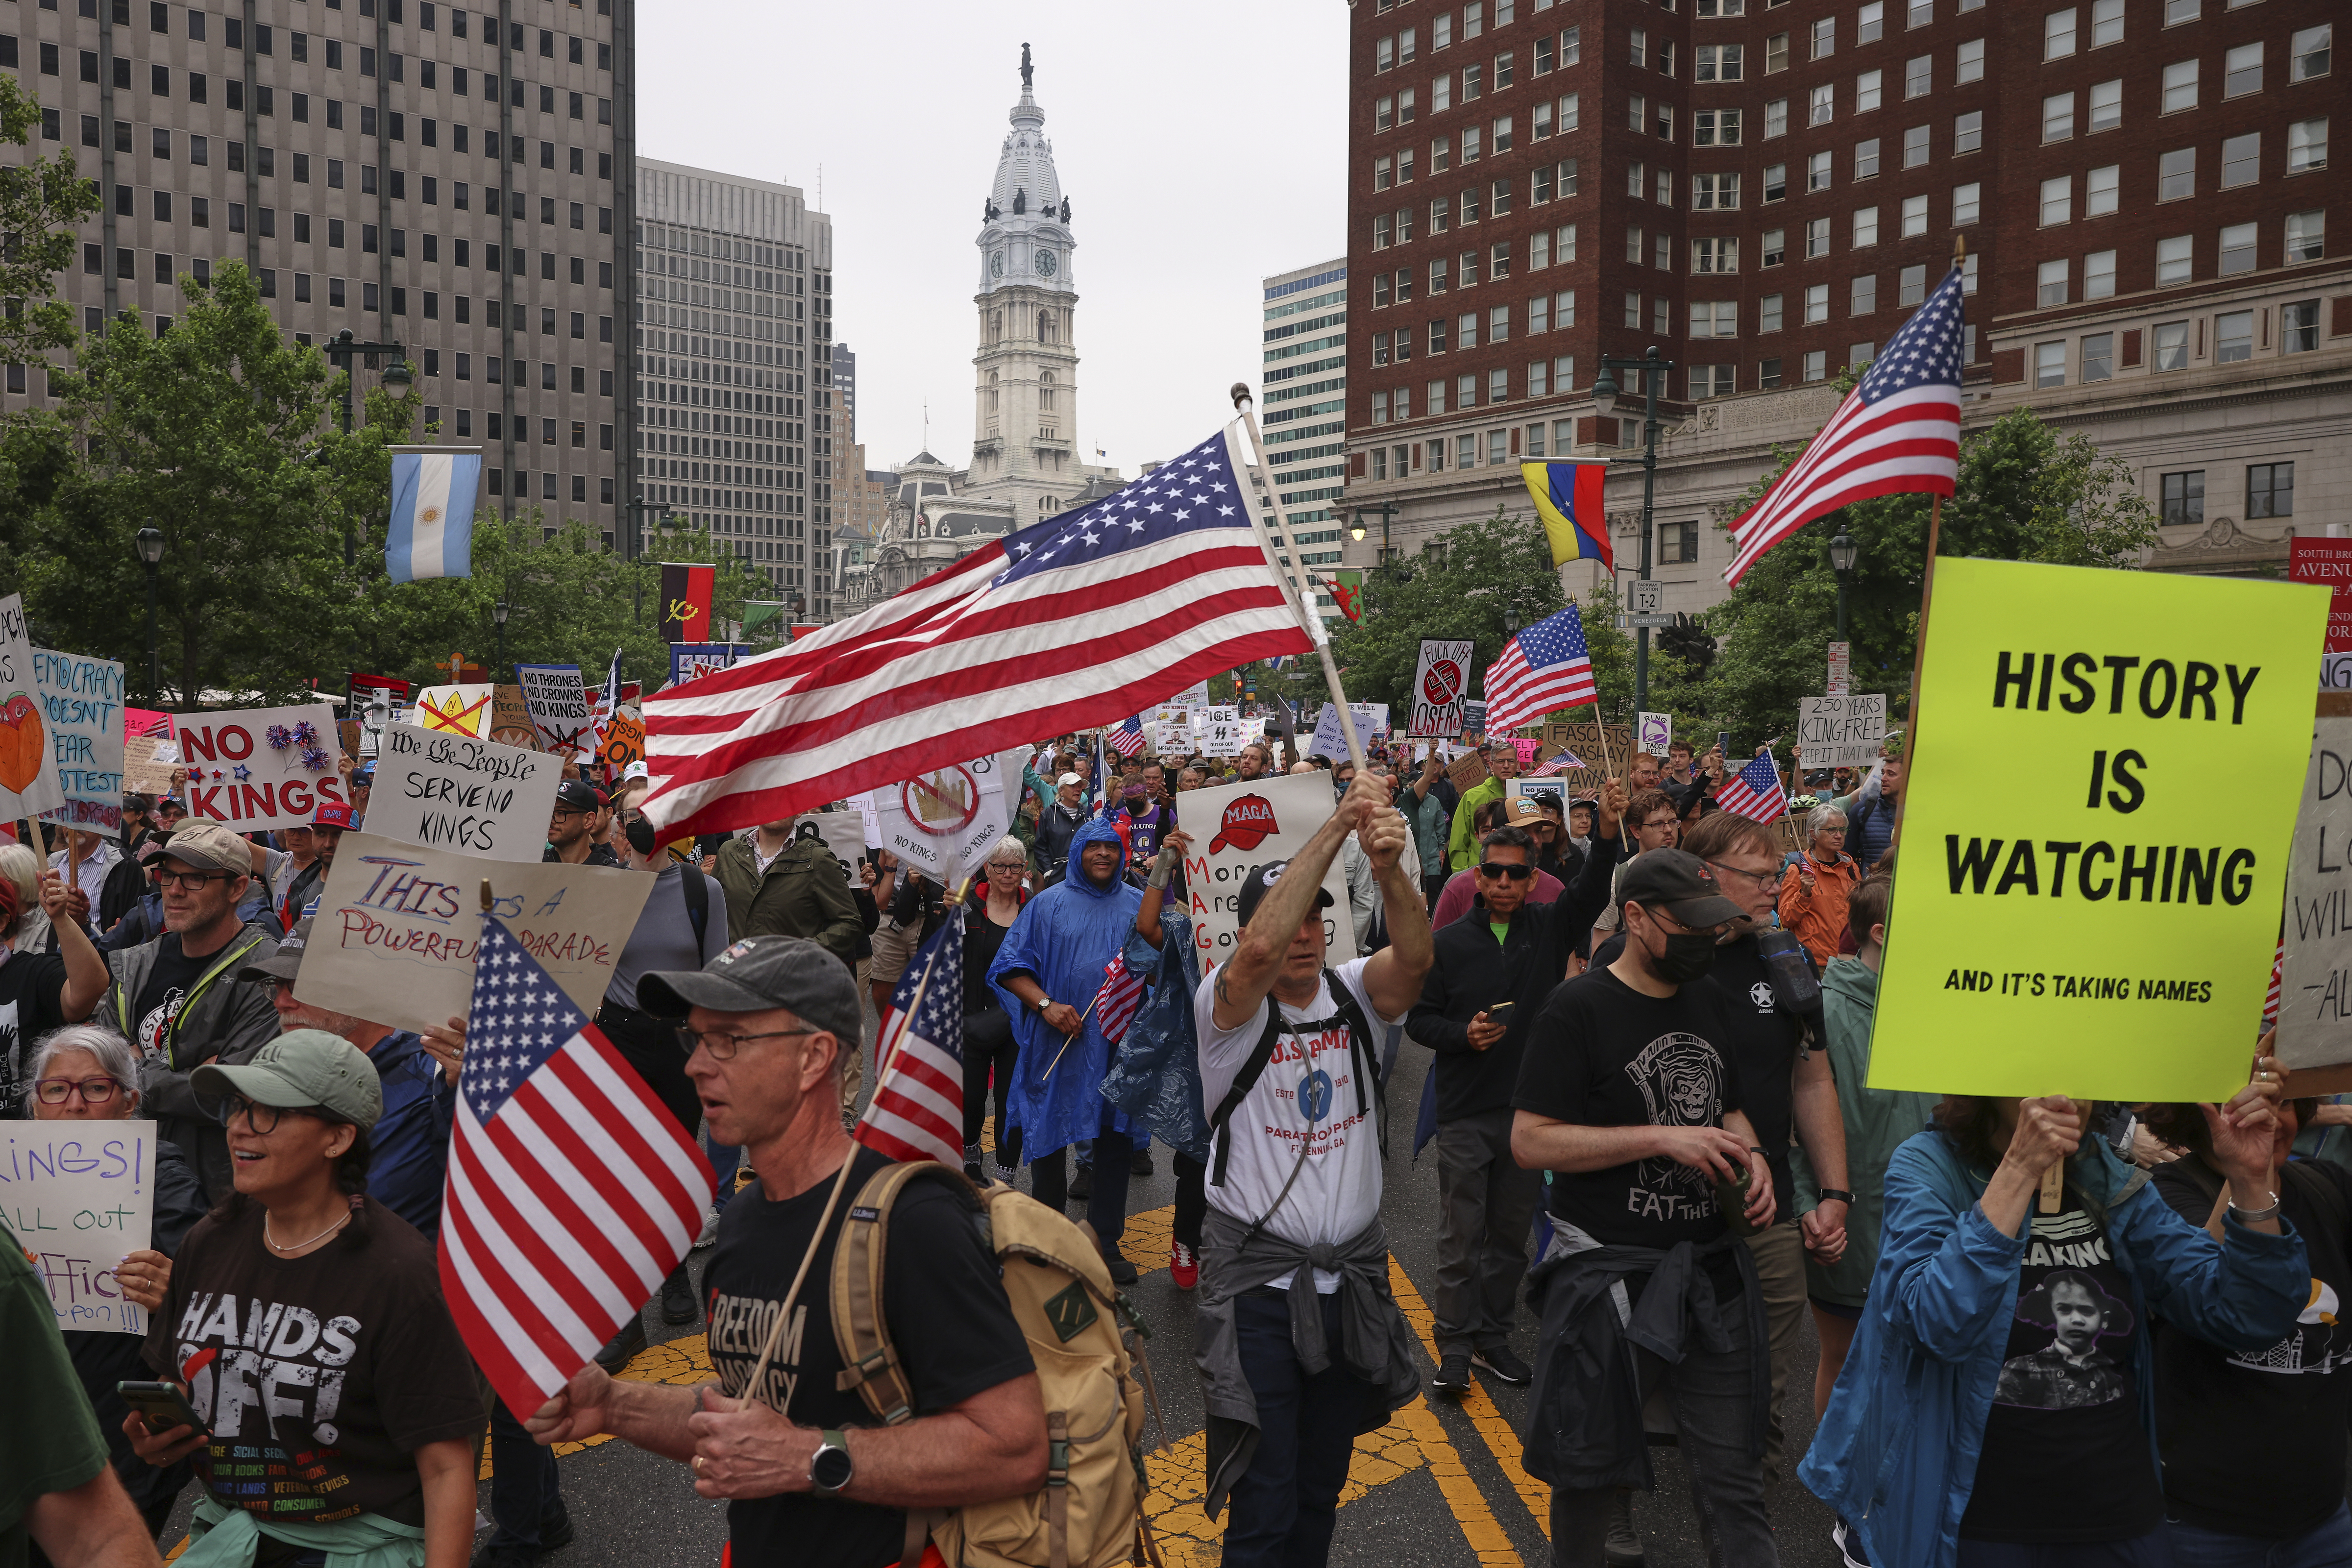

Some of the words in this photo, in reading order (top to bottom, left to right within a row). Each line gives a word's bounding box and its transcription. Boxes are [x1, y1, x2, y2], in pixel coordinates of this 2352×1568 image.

[1723, 401, 1750, 410] INSURANCE
[1752, 396, 1779, 405] COMPANY
[1761, 416, 1791, 424] DECLARATION
[2298, 549, 2332, 558] SOUTH
[1640, 594, 1655, 607] T-2
[1424, 641, 1450, 665] FUCK
[1451, 641, 1472, 665] OFF
[33, 654, 123, 701] EMOCRACY
[524, 672, 538, 685] NO
[538, 674, 582, 687] THRONES
[527, 686, 540, 699] NO
[542, 687, 584, 702] CROWNS
[1993, 651, 2261, 725] HISTORY
[530, 700, 547, 716] NO
[548, 702, 587, 718] KINGS
[1209, 710, 1232, 722] ICE
[1409, 693, 1466, 736] LOSERS
[1812, 699, 1842, 713] 250
[1845, 698, 1881, 716] YEARS
[1241, 720, 1263, 729] FASCIST
[1323, 723, 1337, 734] Pissed
[1644, 715, 1668, 723] RING
[1318, 732, 1336, 741] WAKE
[1553, 725, 1630, 746] FASCISTS
[1801, 717, 1883, 743] KING-FREE
[179, 724, 254, 763] NO
[1569, 744, 1626, 762] SASHAY
[391, 730, 422, 756] We
[425, 739, 456, 763] the
[455, 742, 537, 783] People
[1800, 749, 1820, 763] KEEP
[1819, 748, 1833, 762] IT
[1837, 746, 1862, 762] THAT
[59, 769, 123, 792] OTEST
[1457, 766, 1481, 786] STUPID
[1569, 769, 1623, 789] AWAY
[2086, 749, 2148, 814] IS
[191, 777, 344, 821] KINGS
[404, 772, 486, 808] SERVE
[486, 788, 513, 814] NO
[1226, 804, 1273, 824] MAGA
[418, 810, 497, 851] KINGS
[894, 834, 908, 848] NO
[909, 842, 938, 862] KINGS
[960, 846, 973, 861] NO
[970, 824, 996, 852] KINGS
[696, 851, 703, 859] IS
[1945, 834, 2255, 906] WATCHING
[357, 856, 461, 919] THIS
[534, 886, 567, 918] A
[519, 930, 610, 966] PARADE
[1944, 969, 1993, 993] AND
[2001, 972, 2046, 997] IT'S
[2053, 975, 2130, 1001] TAKING
[2137, 980, 2212, 1004] NAMES
[142, 1033, 153, 1051] FC
[1275, 1088, 1294, 1100] ESTD
[1265, 1113, 1364, 1142] PARATROOPERS
[1291, 1145, 1301, 1153] FT.
[1334, 1137, 1345, 1148] GA
[1628, 1187, 1687, 1222] EAT
[1678, 1200, 1710, 1220] THE
[176, 1291, 362, 1366] HANDS
[707, 1287, 808, 1366] FREEDOM
[177, 1343, 346, 1445] OFF!
[296, 1450, 315, 1466] OUR
[214, 1464, 232, 1476] OUR
[235, 1464, 265, 1476] BOOKS
[269, 1465, 287, 1475] FAIR
[236, 1482, 267, 1495] LANDS
[273, 1481, 311, 1494] VETERAN
[273, 1498, 326, 1512] CONSUMER
[315, 1504, 360, 1523] SCHOOLS
